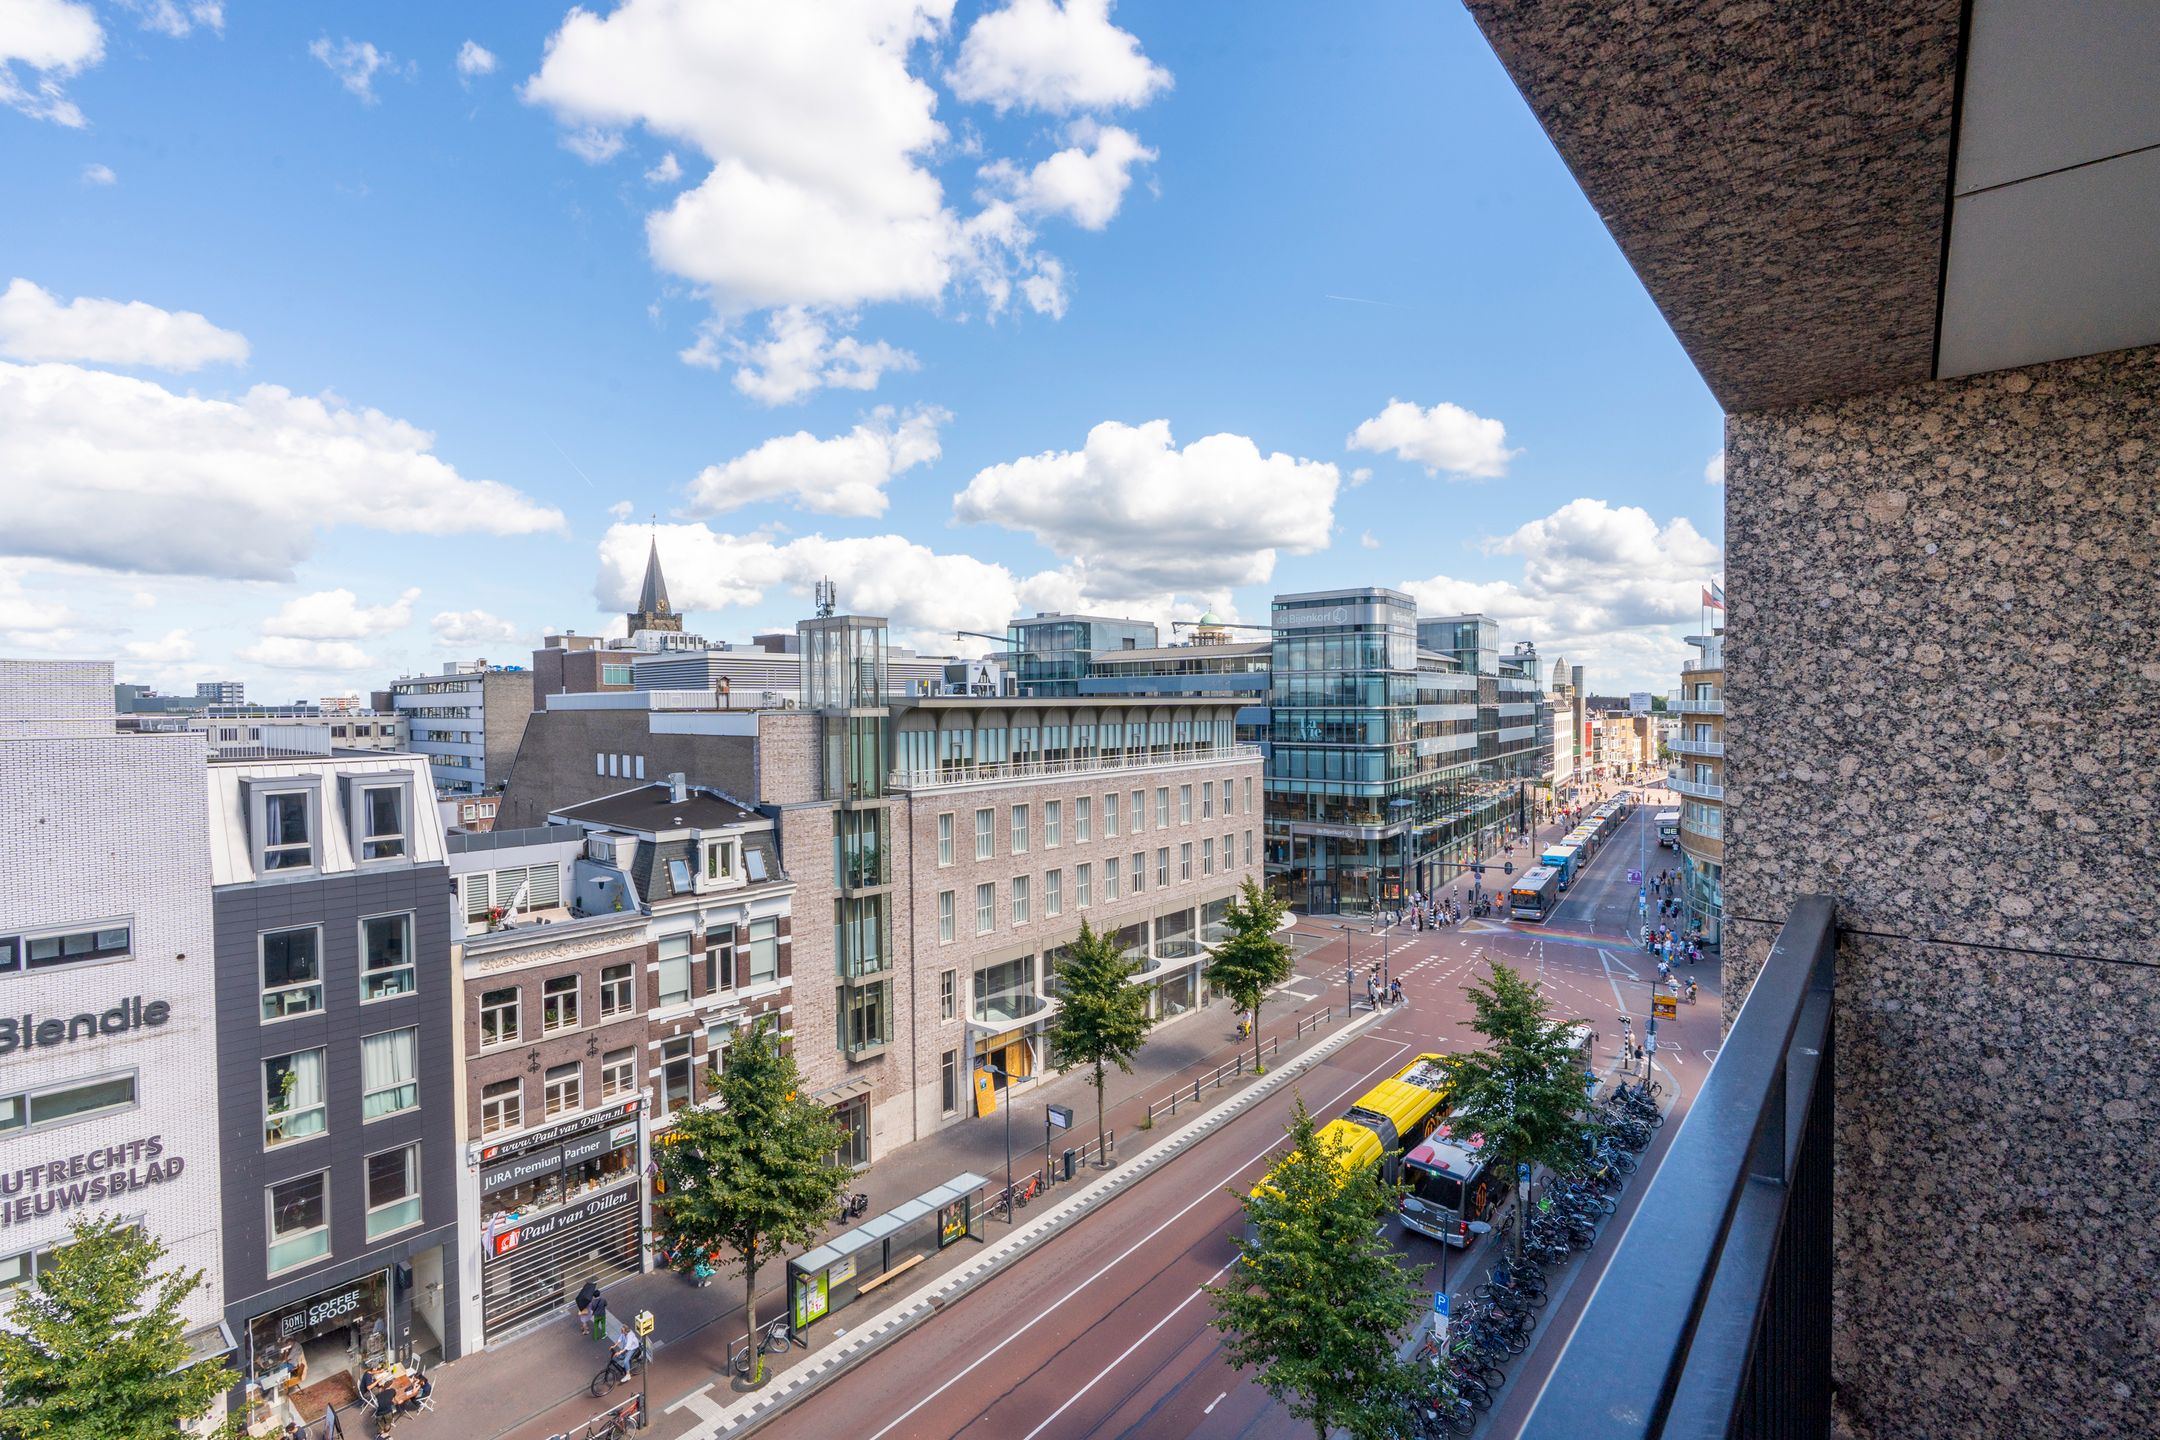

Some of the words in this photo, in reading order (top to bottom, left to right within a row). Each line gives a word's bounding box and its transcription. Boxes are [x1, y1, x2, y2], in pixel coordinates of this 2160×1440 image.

[1663, 827, 1677, 835] WE
[0, 995, 171, 1055] Blendle
[559, 1123, 578, 1135] van
[580, 1107, 624, 1128] Dillen.nl
[1, 1135, 163, 1195] UTRECHTS
[484, 1171, 512, 1190] JURA
[514, 1154, 561, 1177] Premium
[564, 1141, 600, 1160] Partner
[0, 1156, 185, 1225] IEUWSBLAD
[521, 1218, 555, 1241] Paul
[558, 1210, 583, 1227] van
[587, 1192, 628, 1216] Dillen
[309, 1289, 360, 1316] COFFEE
[1438, 1295, 1446, 1306] P
[284, 1314, 304, 1330] 30ML
